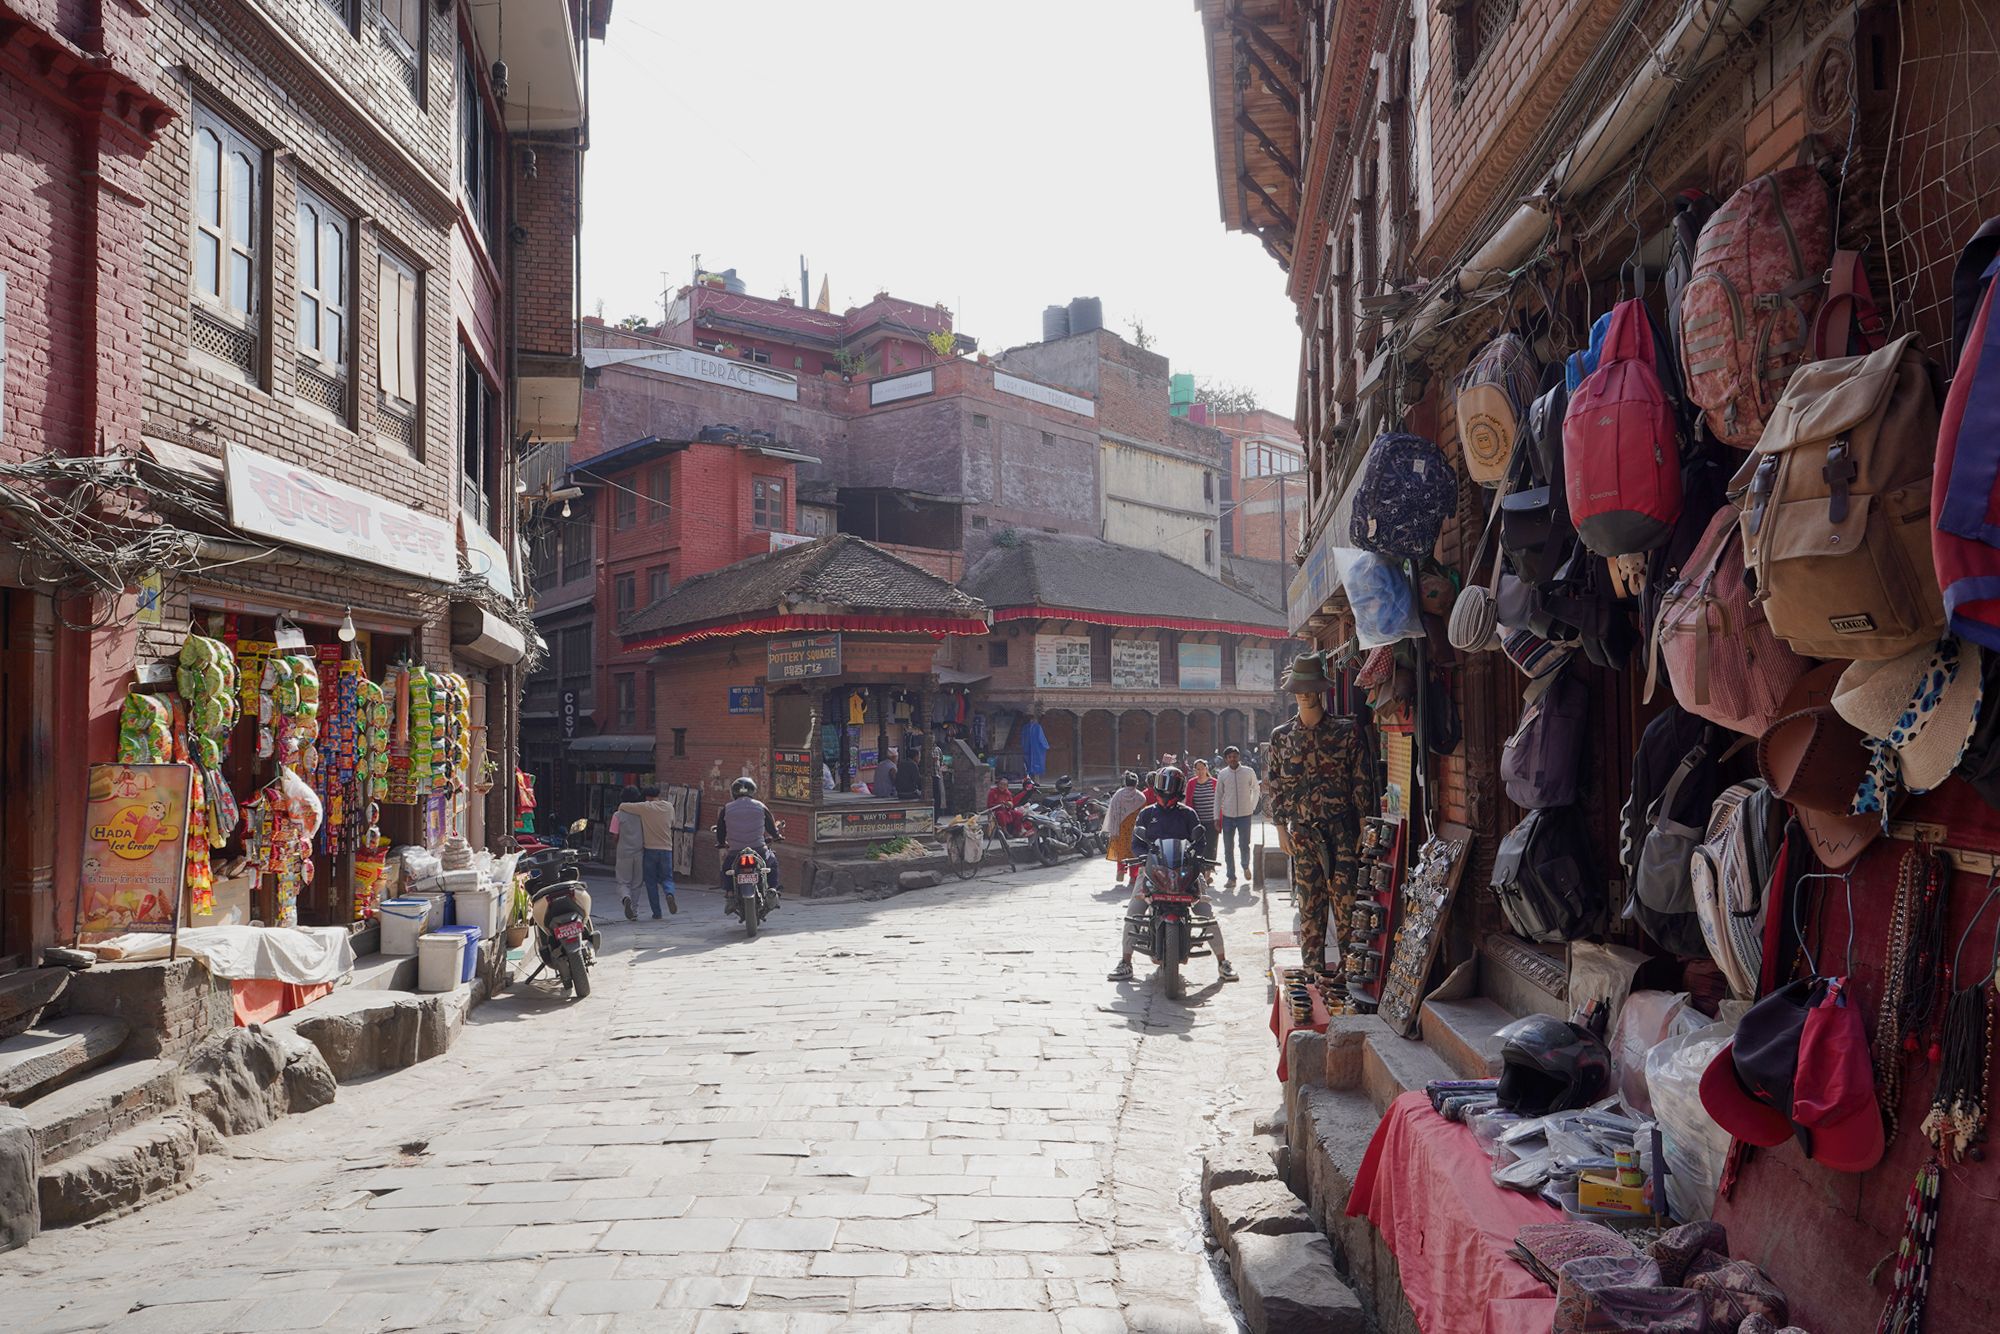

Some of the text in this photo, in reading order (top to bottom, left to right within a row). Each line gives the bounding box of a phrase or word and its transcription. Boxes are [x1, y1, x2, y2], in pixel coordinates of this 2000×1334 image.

[691, 357, 756, 387] TERRACE
[791, 640, 805, 648] WAY
[769, 647, 836, 664] POTTERY SQUARE
[564, 692, 574, 737] COSY
[878, 812, 887, 820] TO
[95, 827, 132, 838] HADA
[845, 823, 876, 833] POTTERY
[110, 840, 155, 850] Ice Cream
